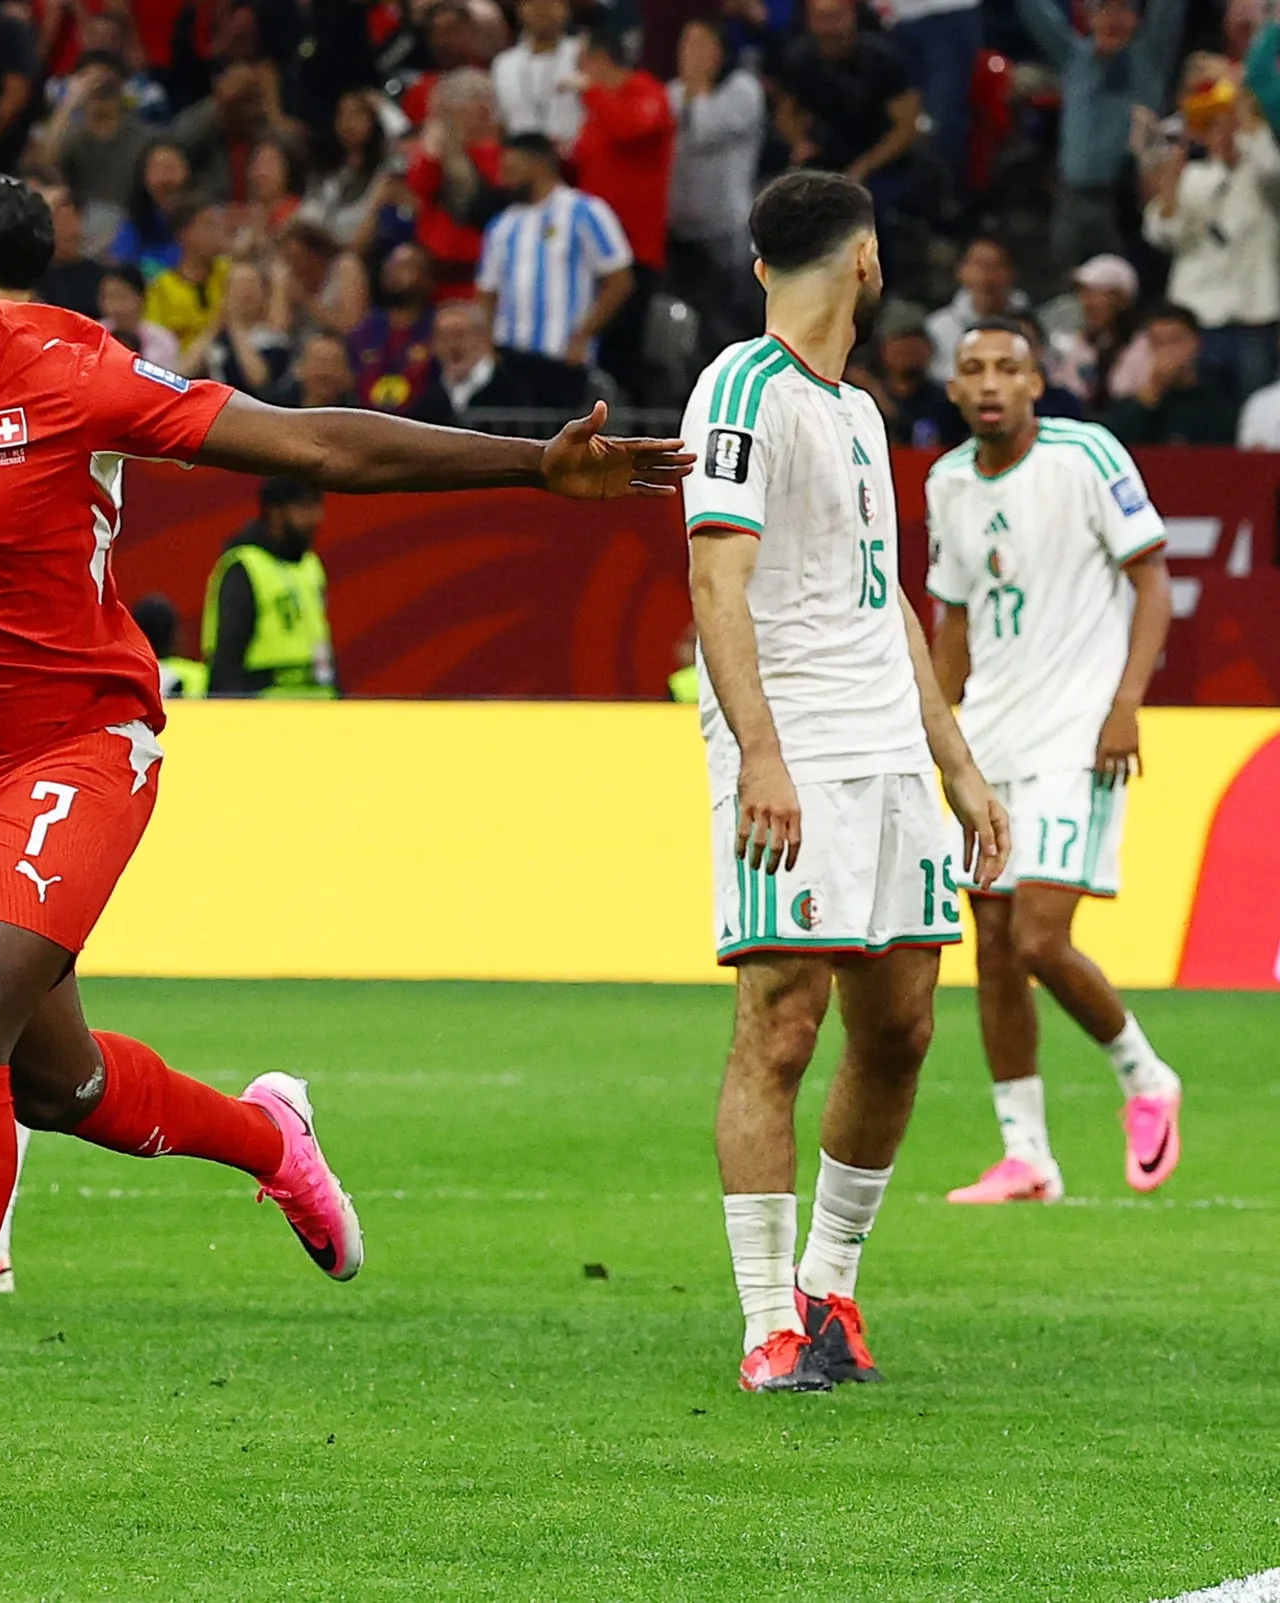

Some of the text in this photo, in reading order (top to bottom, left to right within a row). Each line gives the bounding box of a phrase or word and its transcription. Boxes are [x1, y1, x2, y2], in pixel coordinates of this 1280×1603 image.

[858, 538, 887, 609] 15
[987, 584, 1024, 638] 17
[24, 780, 80, 857] 7
[1038, 817, 1078, 868] 17
